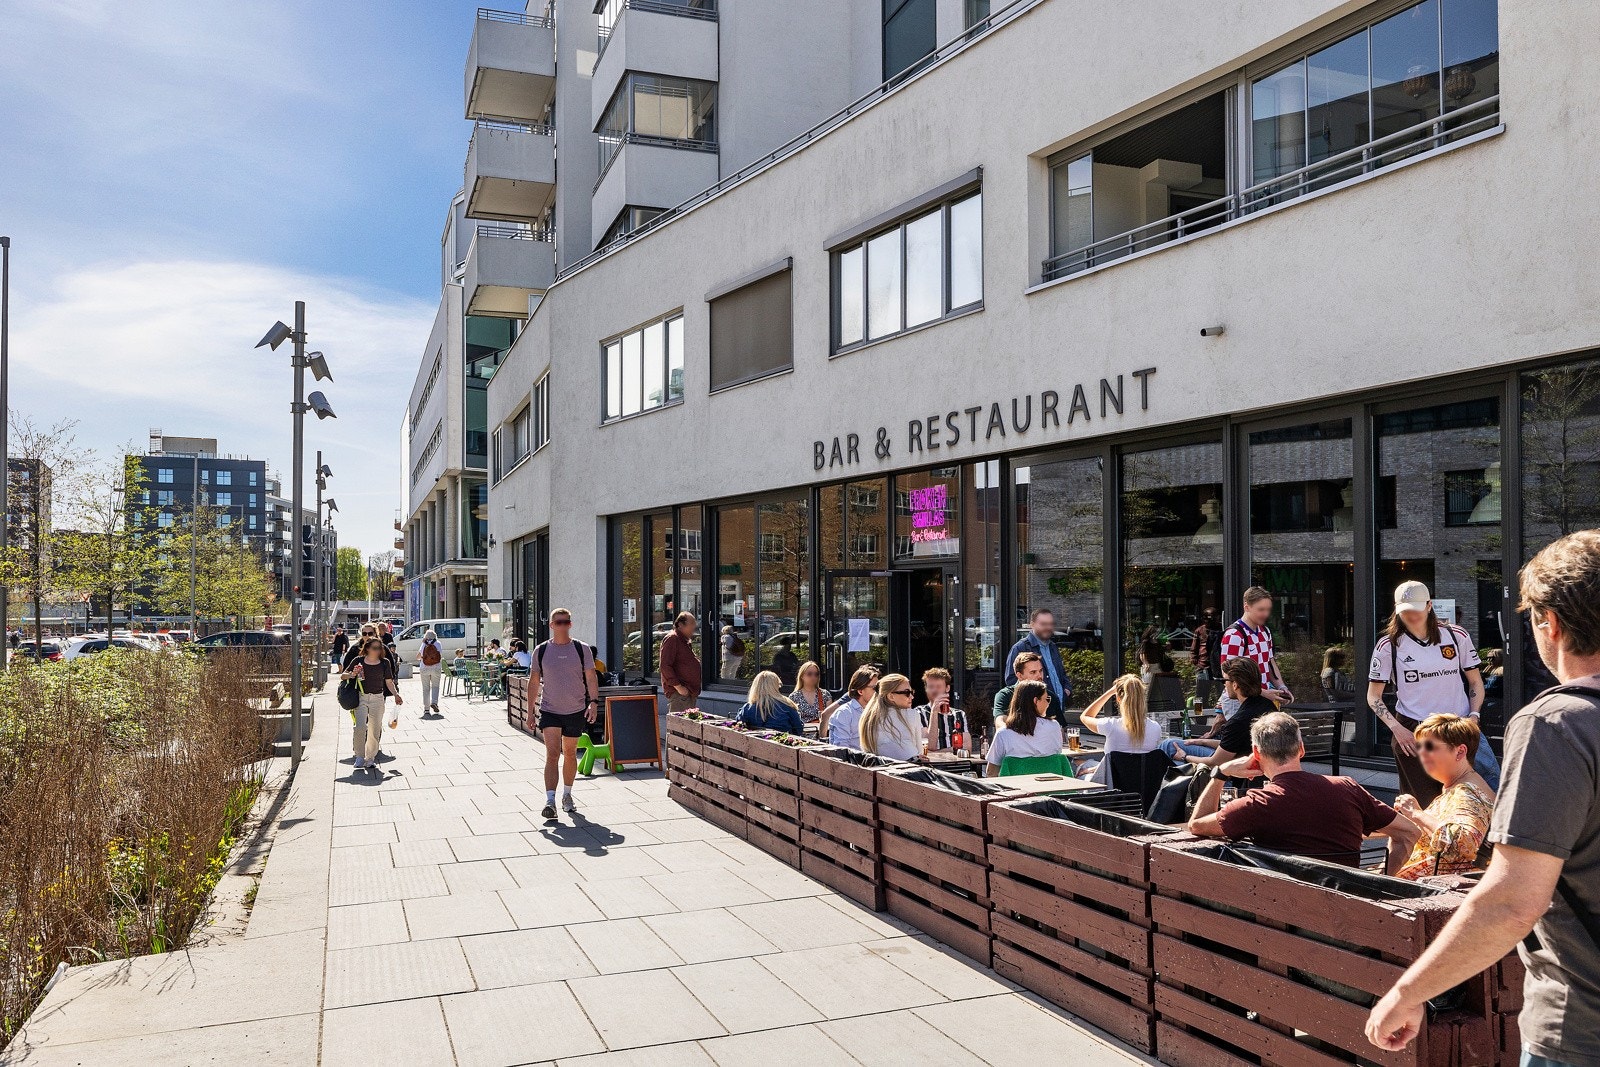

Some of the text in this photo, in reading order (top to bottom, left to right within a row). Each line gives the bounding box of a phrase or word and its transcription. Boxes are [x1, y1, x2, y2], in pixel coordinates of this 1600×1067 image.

[814, 367, 1157, 471] BAR & RESTAURANT
